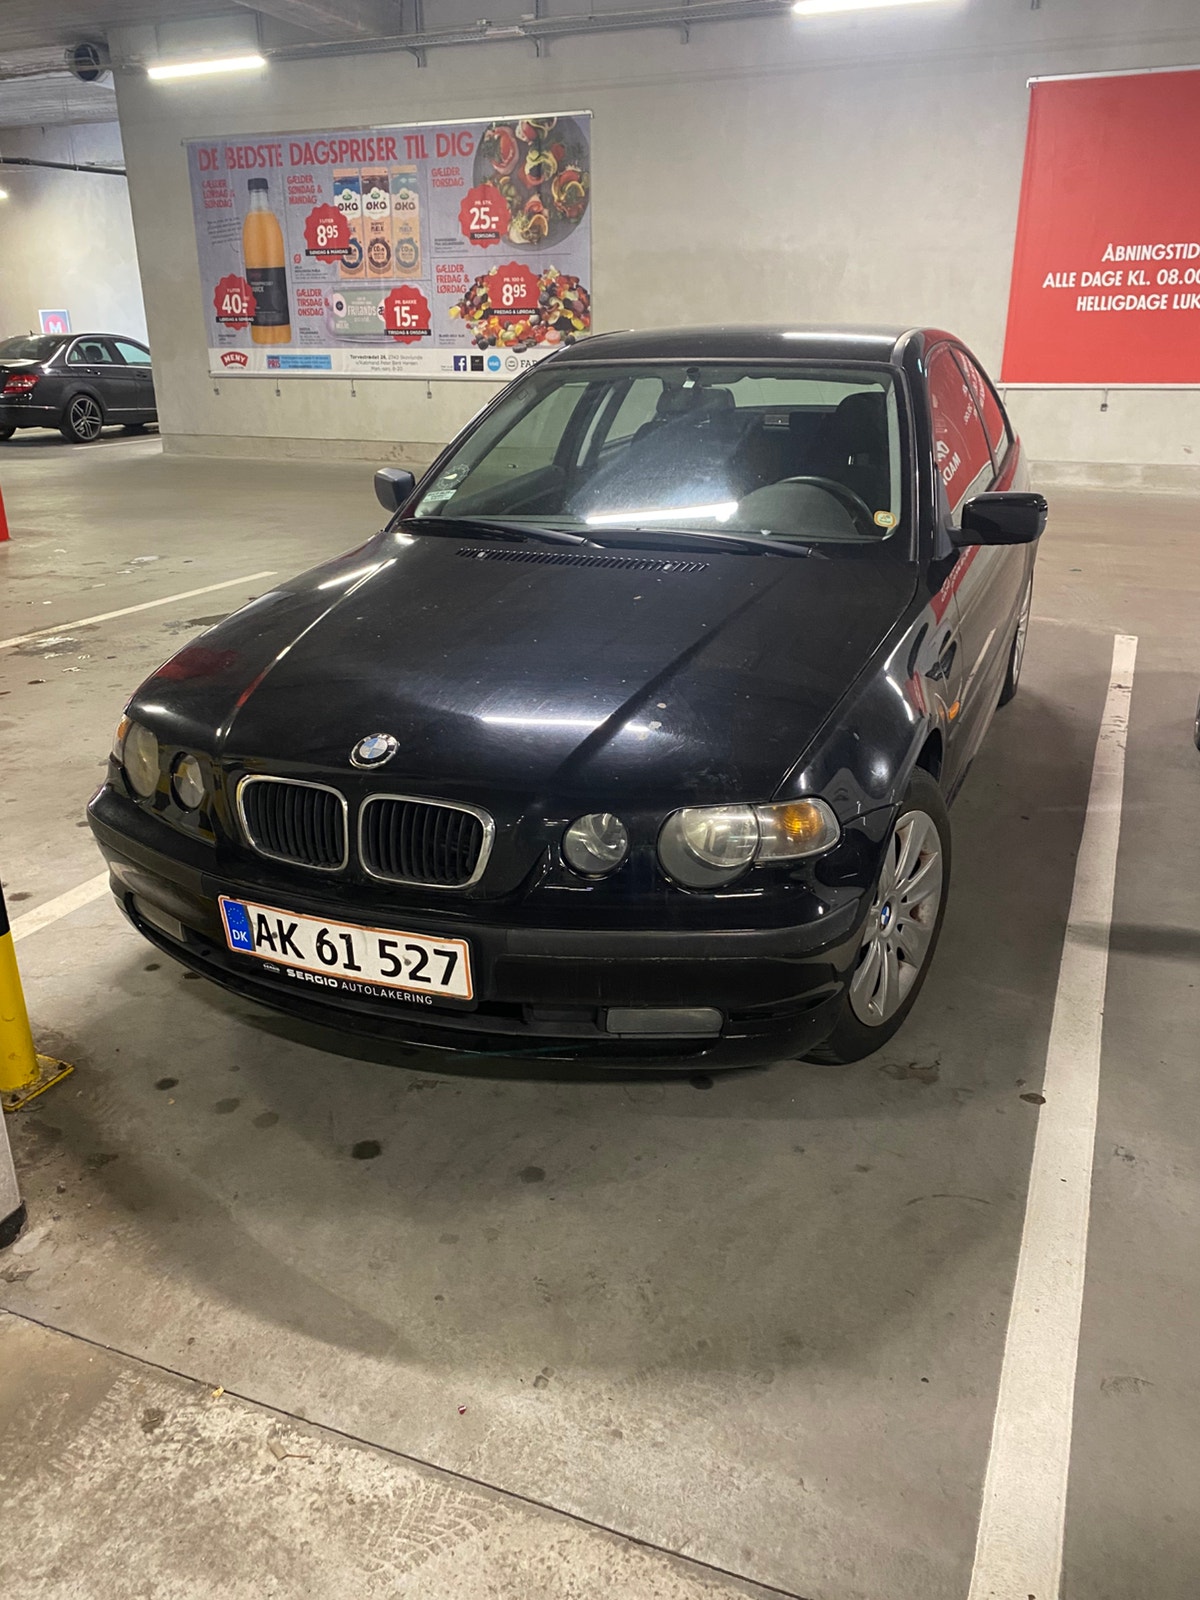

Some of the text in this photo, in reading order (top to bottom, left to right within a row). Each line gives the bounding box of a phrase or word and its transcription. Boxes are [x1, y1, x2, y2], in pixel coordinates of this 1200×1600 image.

[198, 131, 475, 171] DE BEDSTE DAGSPRISER TIL DIG
[431, 167, 460, 177] GÆLDER
[432, 177, 465, 187] TORSDAG
[337, 202, 359, 211] ØKO
[366, 201, 387, 210] ØKO
[394, 201, 416, 211] ØKO
[435, 264, 464, 273] GÆLDER
[436, 273, 470, 283] FREDAG &
[1042, 272, 1077, 288] ALLE
[1080, 270, 1123, 287] DAGE
[1127, 270, 1151, 286] KL.
[296, 288, 322, 297] GÆLDER
[437, 284, 467, 293] LØRDAG
[296, 298, 330, 307] TIRSDAG &
[1076, 293, 1200, 311] HELLIGDAGE LUK
[297, 308, 324, 316] ONSDAG
[223, 353, 246, 364] MENY
[232, 929, 248, 943] DK
[256, 913, 458, 986] AK 61 527
[286, 968, 433, 1005] SERGIO AUTOLAKERING
